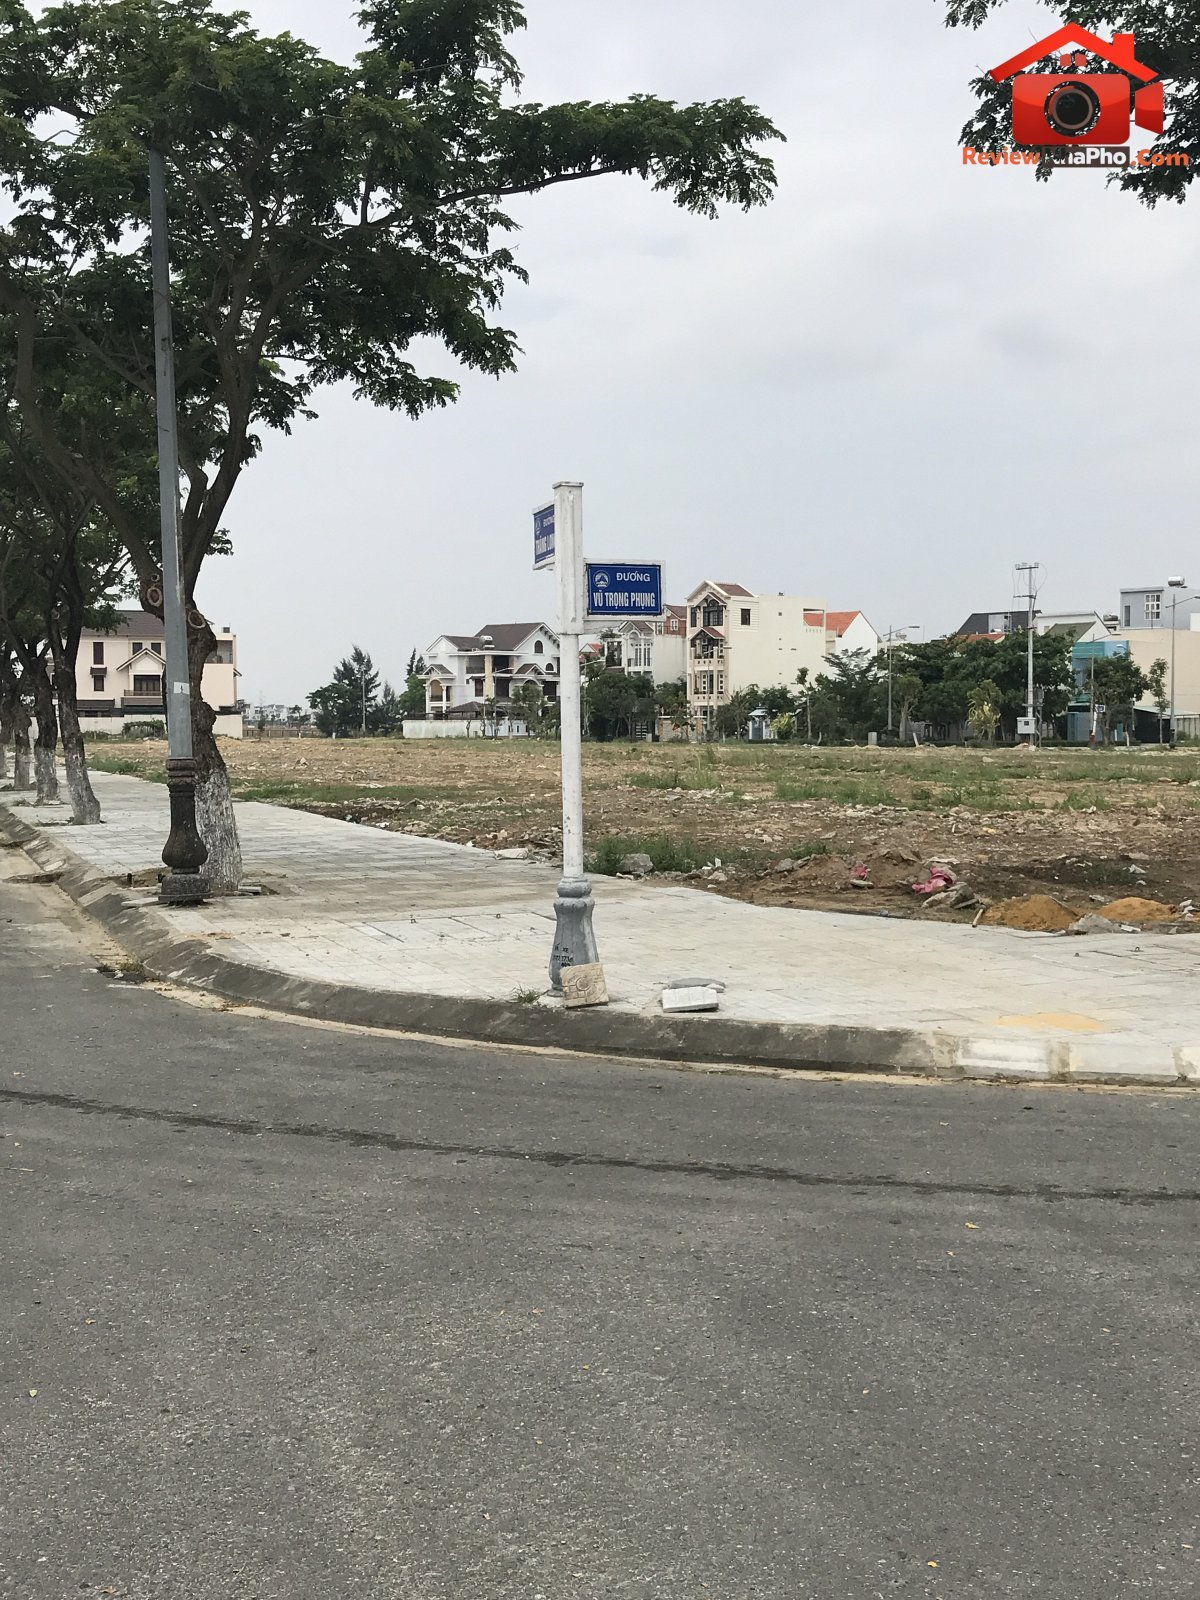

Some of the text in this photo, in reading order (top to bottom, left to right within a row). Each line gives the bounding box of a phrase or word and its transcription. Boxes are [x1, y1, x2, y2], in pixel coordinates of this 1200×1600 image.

[593, 589, 656, 609] VŨ TRỌNG PHỤNG
